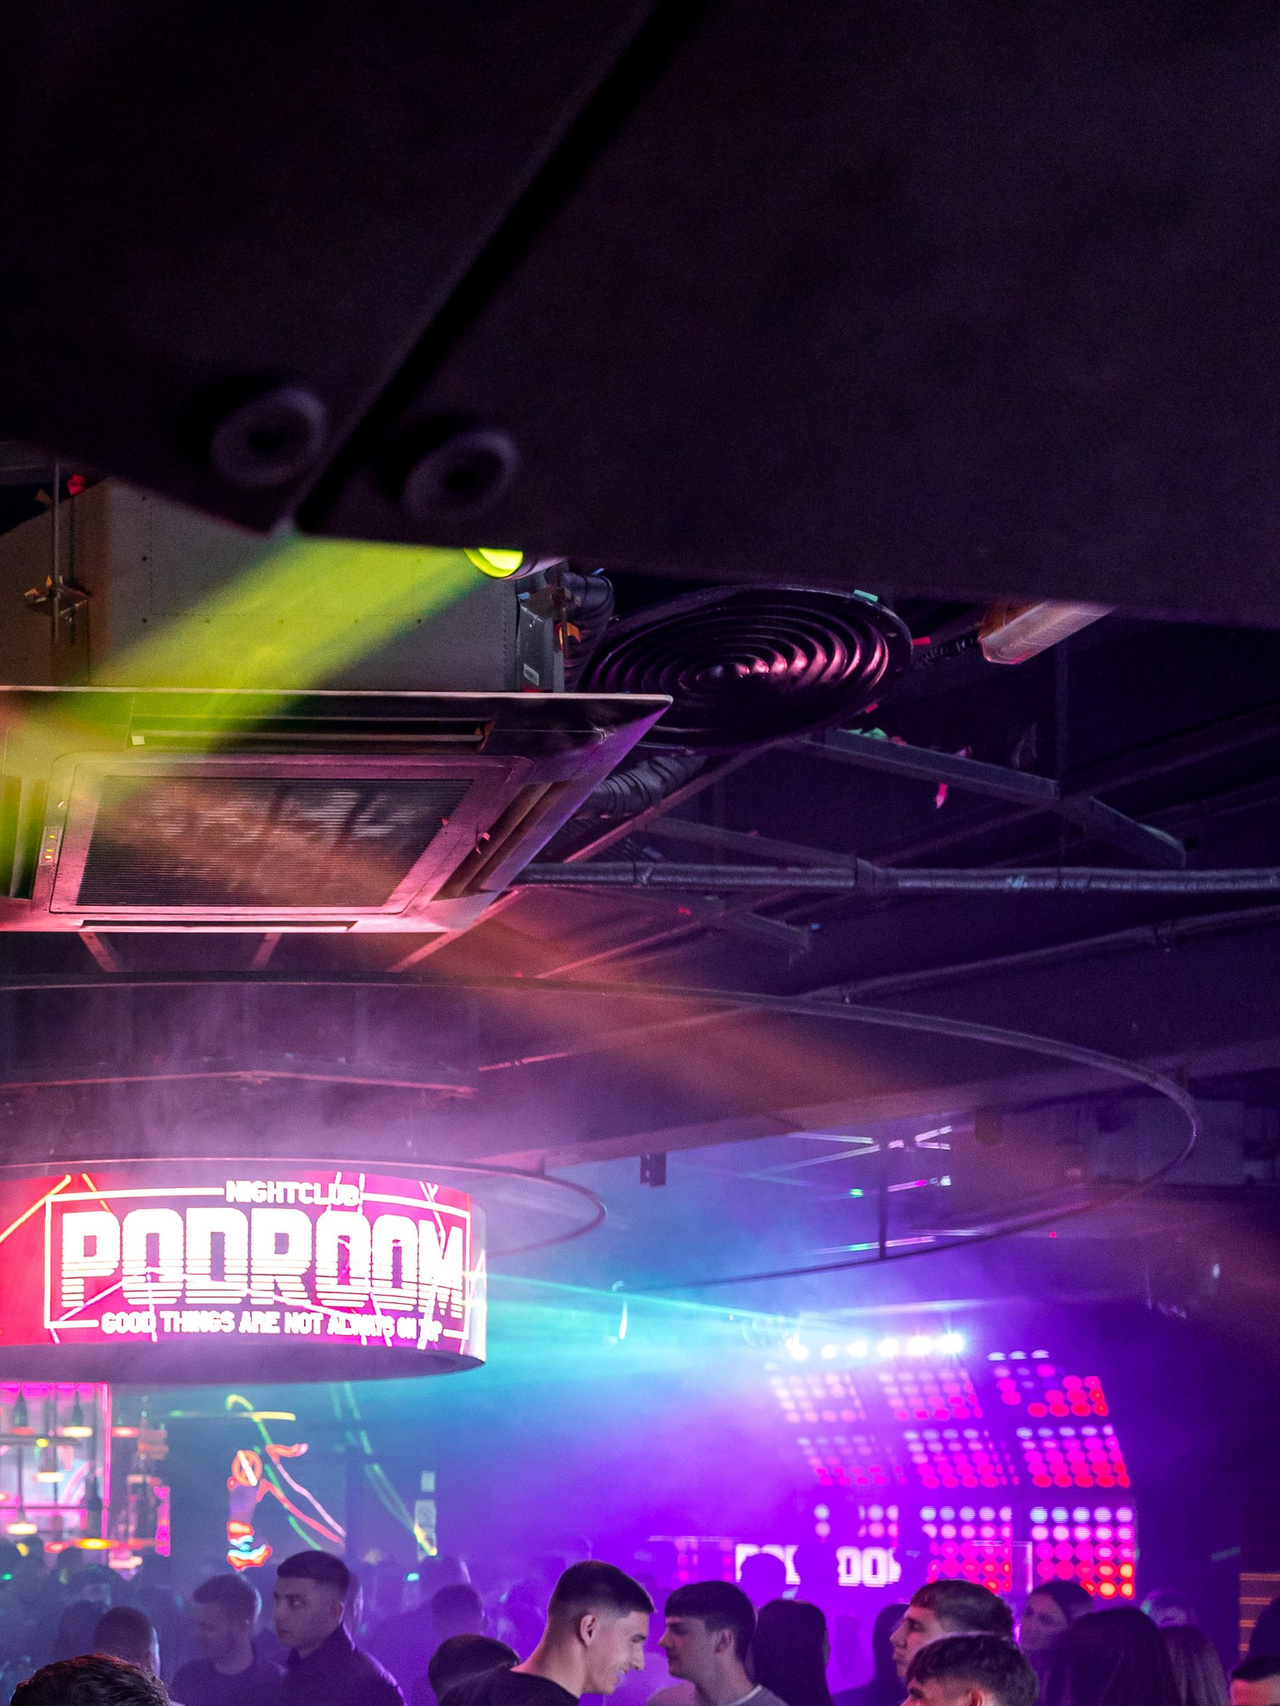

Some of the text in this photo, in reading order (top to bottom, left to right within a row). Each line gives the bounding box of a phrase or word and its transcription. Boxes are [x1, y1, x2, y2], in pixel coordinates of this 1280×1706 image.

[225, 1180, 361, 1207] NIGHTCLUB
[61, 1207, 463, 1319] PODROOM
[101, 1311, 157, 1334] GOOD
[159, 1310, 235, 1333] THINGS
[239, 1310, 281, 1334] ARE
[284, 1311, 323, 1334] NOT
